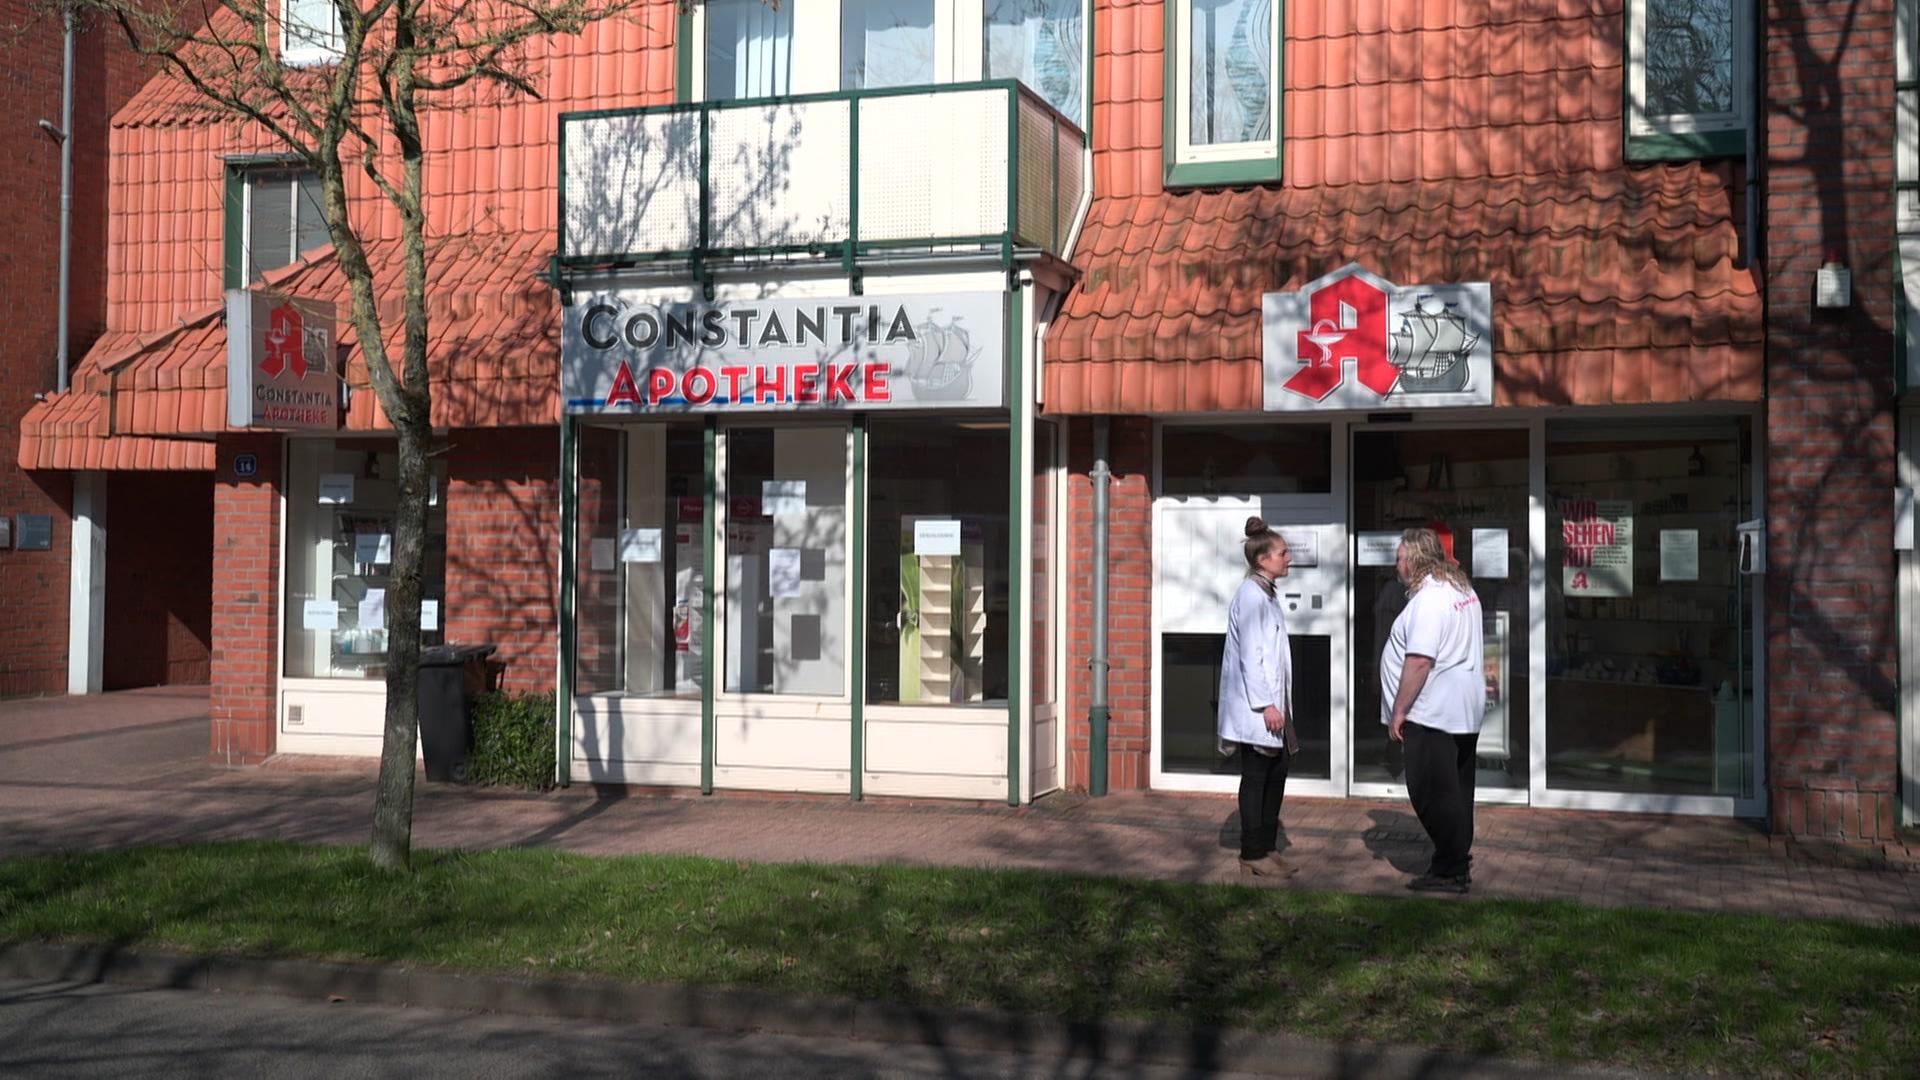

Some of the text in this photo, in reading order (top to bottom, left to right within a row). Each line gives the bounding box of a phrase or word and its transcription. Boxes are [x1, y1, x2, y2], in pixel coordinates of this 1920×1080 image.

[580, 303, 919, 351] CONSTANTIA
[606, 358, 893, 407] APOTHEKE
[255, 383, 332, 407] CONSTANTIA
[263, 404, 328, 424] APOTHEKE
[1562, 500, 1598, 523] WIR
[1562, 522, 1616, 546] SEHEN
[1562, 545, 1595, 569] ROT
